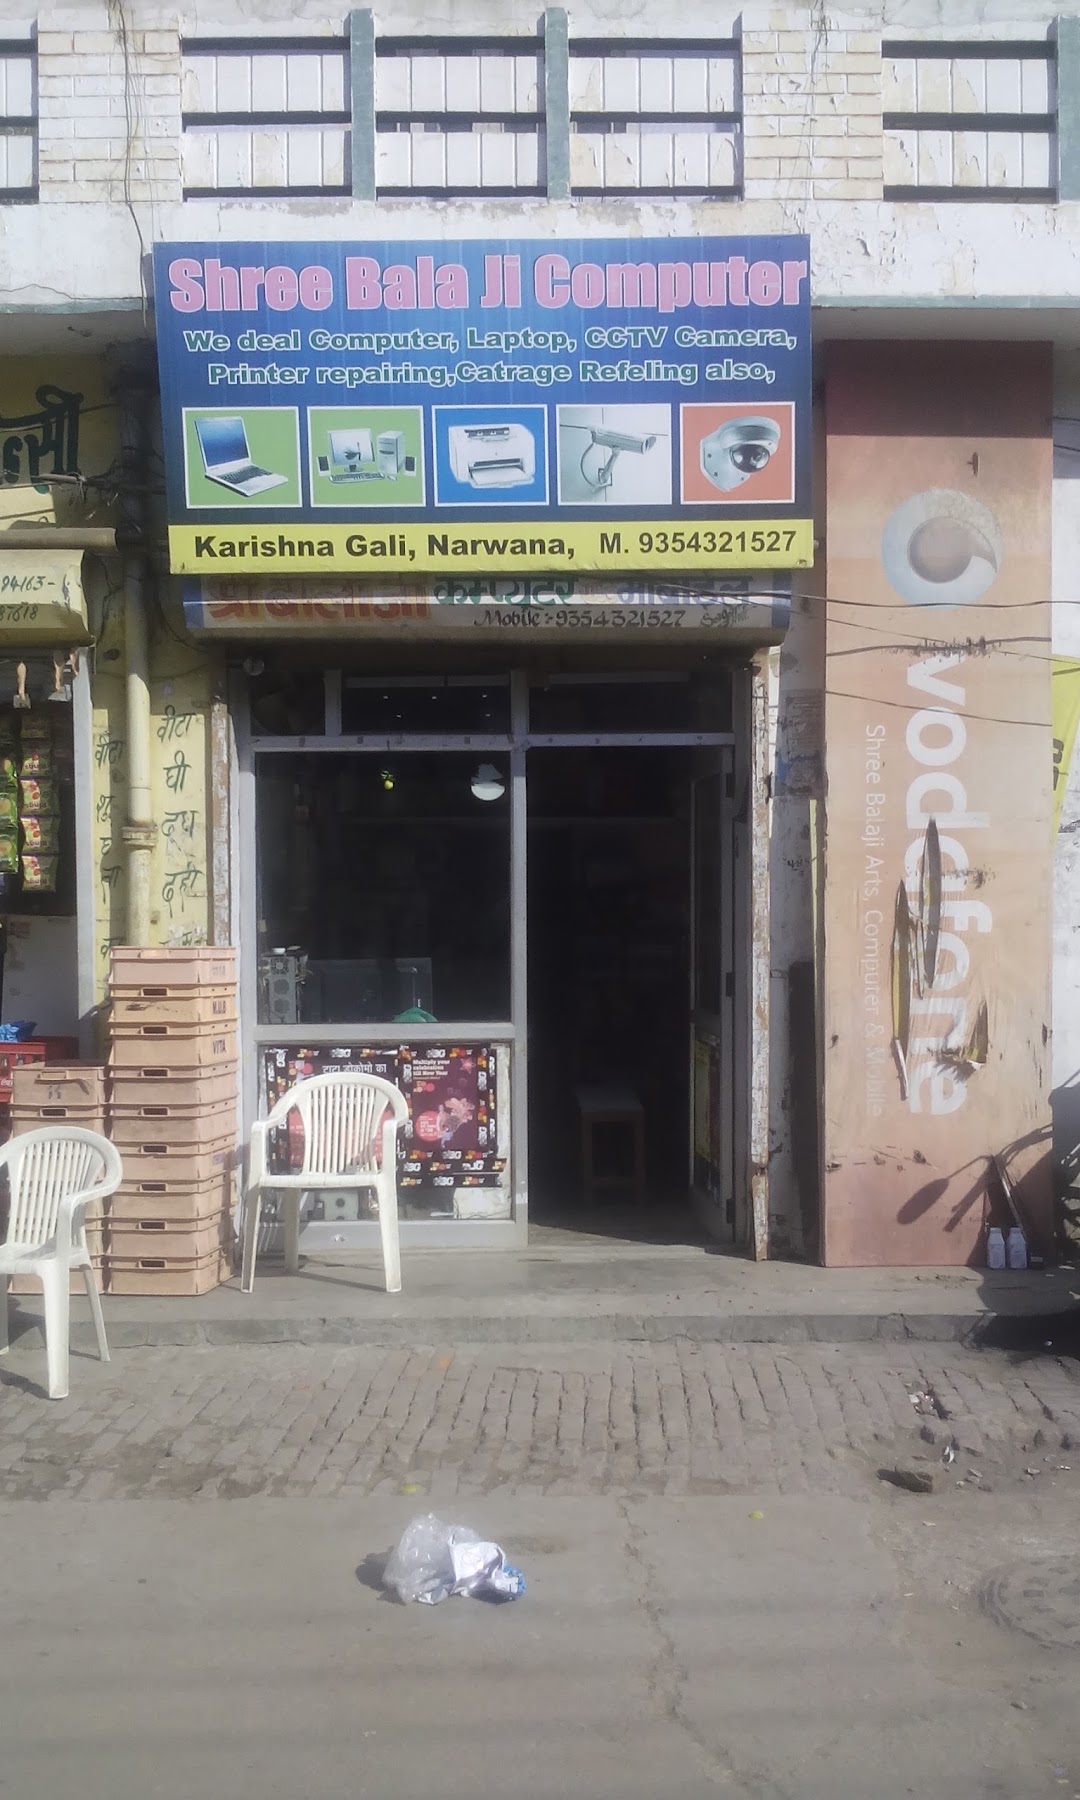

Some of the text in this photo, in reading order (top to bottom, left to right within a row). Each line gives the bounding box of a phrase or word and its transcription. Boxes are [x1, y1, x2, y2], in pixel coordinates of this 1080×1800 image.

[168, 254, 807, 313] Shree Bala Ji Computer
[183, 325, 797, 354] We deal Computer, Laptop, CCTV Camera,
[209, 362, 310, 385] Printer
[580, 360, 698, 386] Refeling
[705, 358, 775, 384] also,
[194, 530, 797, 561] Karishna Gali, Narwana, M. 9354321527
[865, 724, 886, 784] Shree
[861, 792, 886, 847] Balaji
[861, 855, 886, 901] Arts,
[861, 909, 884, 1016] Computer
[864, 1022, 884, 1038] &
